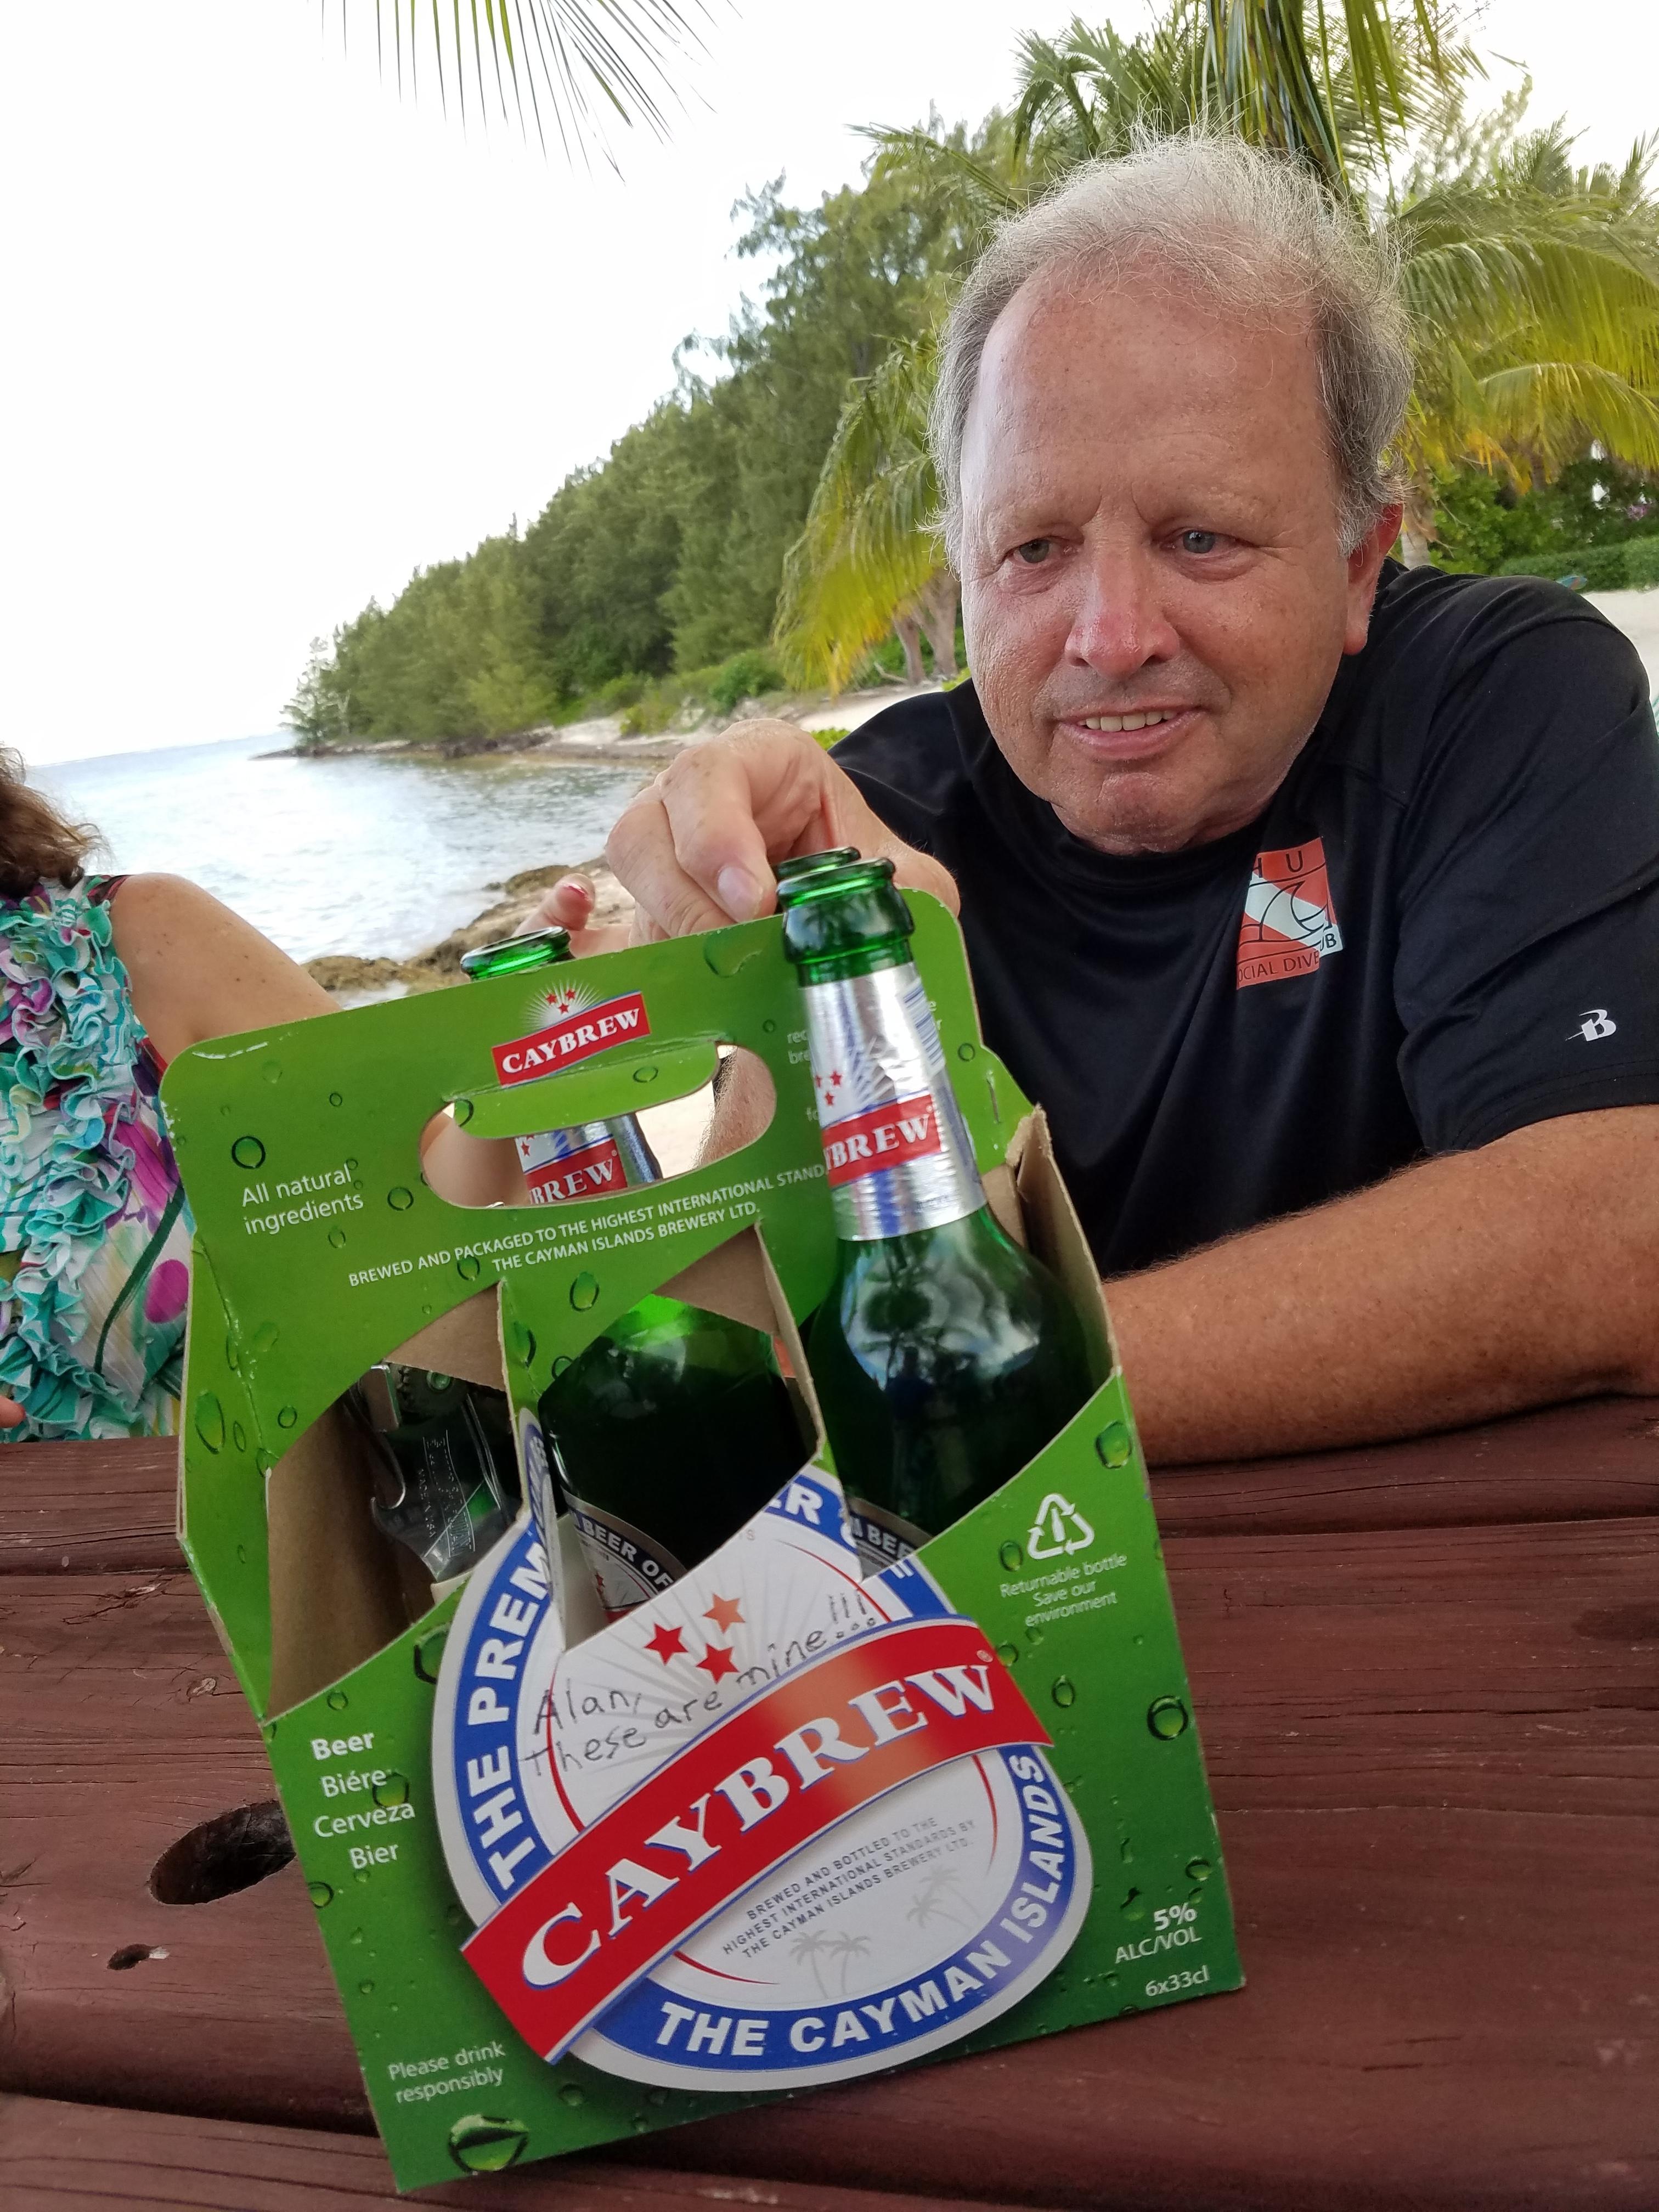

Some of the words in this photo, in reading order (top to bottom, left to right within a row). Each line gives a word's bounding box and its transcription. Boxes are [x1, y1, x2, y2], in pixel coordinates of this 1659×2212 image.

[501, 1008, 641, 1074] CAYBREW
[241, 1182, 269, 1207] All
[275, 1162, 352, 1199] natural
[243, 1193, 364, 1235] ingredients
[348, 1260, 414, 1287] BREWED
[417, 1250, 452, 1270] AND
[454, 1231, 534, 1261] PACKAGED
[534, 1226, 557, 1243] TO
[557, 1220, 589, 1238] THE
[590, 1205, 654, 1232] HIGHEST
[658, 1177, 774, 1217] INTERNATIONAL
[776, 1164, 827, 1187] STAND
[491, 1255, 523, 1272] THE
[524, 1240, 589, 1266] CAYMAN
[591, 1227, 654, 1251] ISLANDS
[658, 1208, 725, 1238] BREWERY
[728, 1201, 761, 1221] LTD.
[581, 1516, 639, 1563] BEER
[1000, 1566, 1081, 1598] Returnable
[1082, 1553, 1127, 1576] bottle
[1032, 1588, 1068, 1607] Save
[1070, 1580, 1097, 1597] our
[1025, 1592, 1118, 1627] environment
[310, 1731, 375, 1760] Beer
[520, 1725, 646, 1778] These
[653, 1691, 723, 1729] are
[314, 1802, 416, 1838] Cerveza
[466, 1745, 537, 1891] THE
[522, 1663, 995, 1988] CAYBREW
[349, 1843, 399, 1870] Bier
[746, 1882, 801, 1920] BREWED
[804, 1866, 831, 1887] AND
[833, 1837, 891, 1870] BOTTLED
[891, 1828, 911, 1841] TO
[911, 1817, 938, 1833] THE
[655, 2001, 770, 2057] THE
[789, 1939, 1012, 2053] CAYMAN
[1000, 1753, 1066, 1945] ISLANDS
[723, 1912, 778, 1955] HIGHEST
[781, 1858, 883, 1917] INTERNATIONAL
[883, 1826, 957, 1862] STANDARDS
[958, 1819, 976, 1832] BY
[742, 1937, 770, 1959] THE
[771, 1904, 825, 1940] CAYMAN
[826, 1874, 881, 1908] ISLANDS
[883, 1847, 943, 1879] BREWERY
[1153, 1902, 1198, 1931] 5%
[1115, 1926, 1203, 1964] ALC/VOL
[1145, 1965, 1210, 1996] 6x33cl
[387, 2057, 450, 2081] Please
[454, 2040, 506, 2066] drink
[395, 2066, 504, 2104] responsibly
